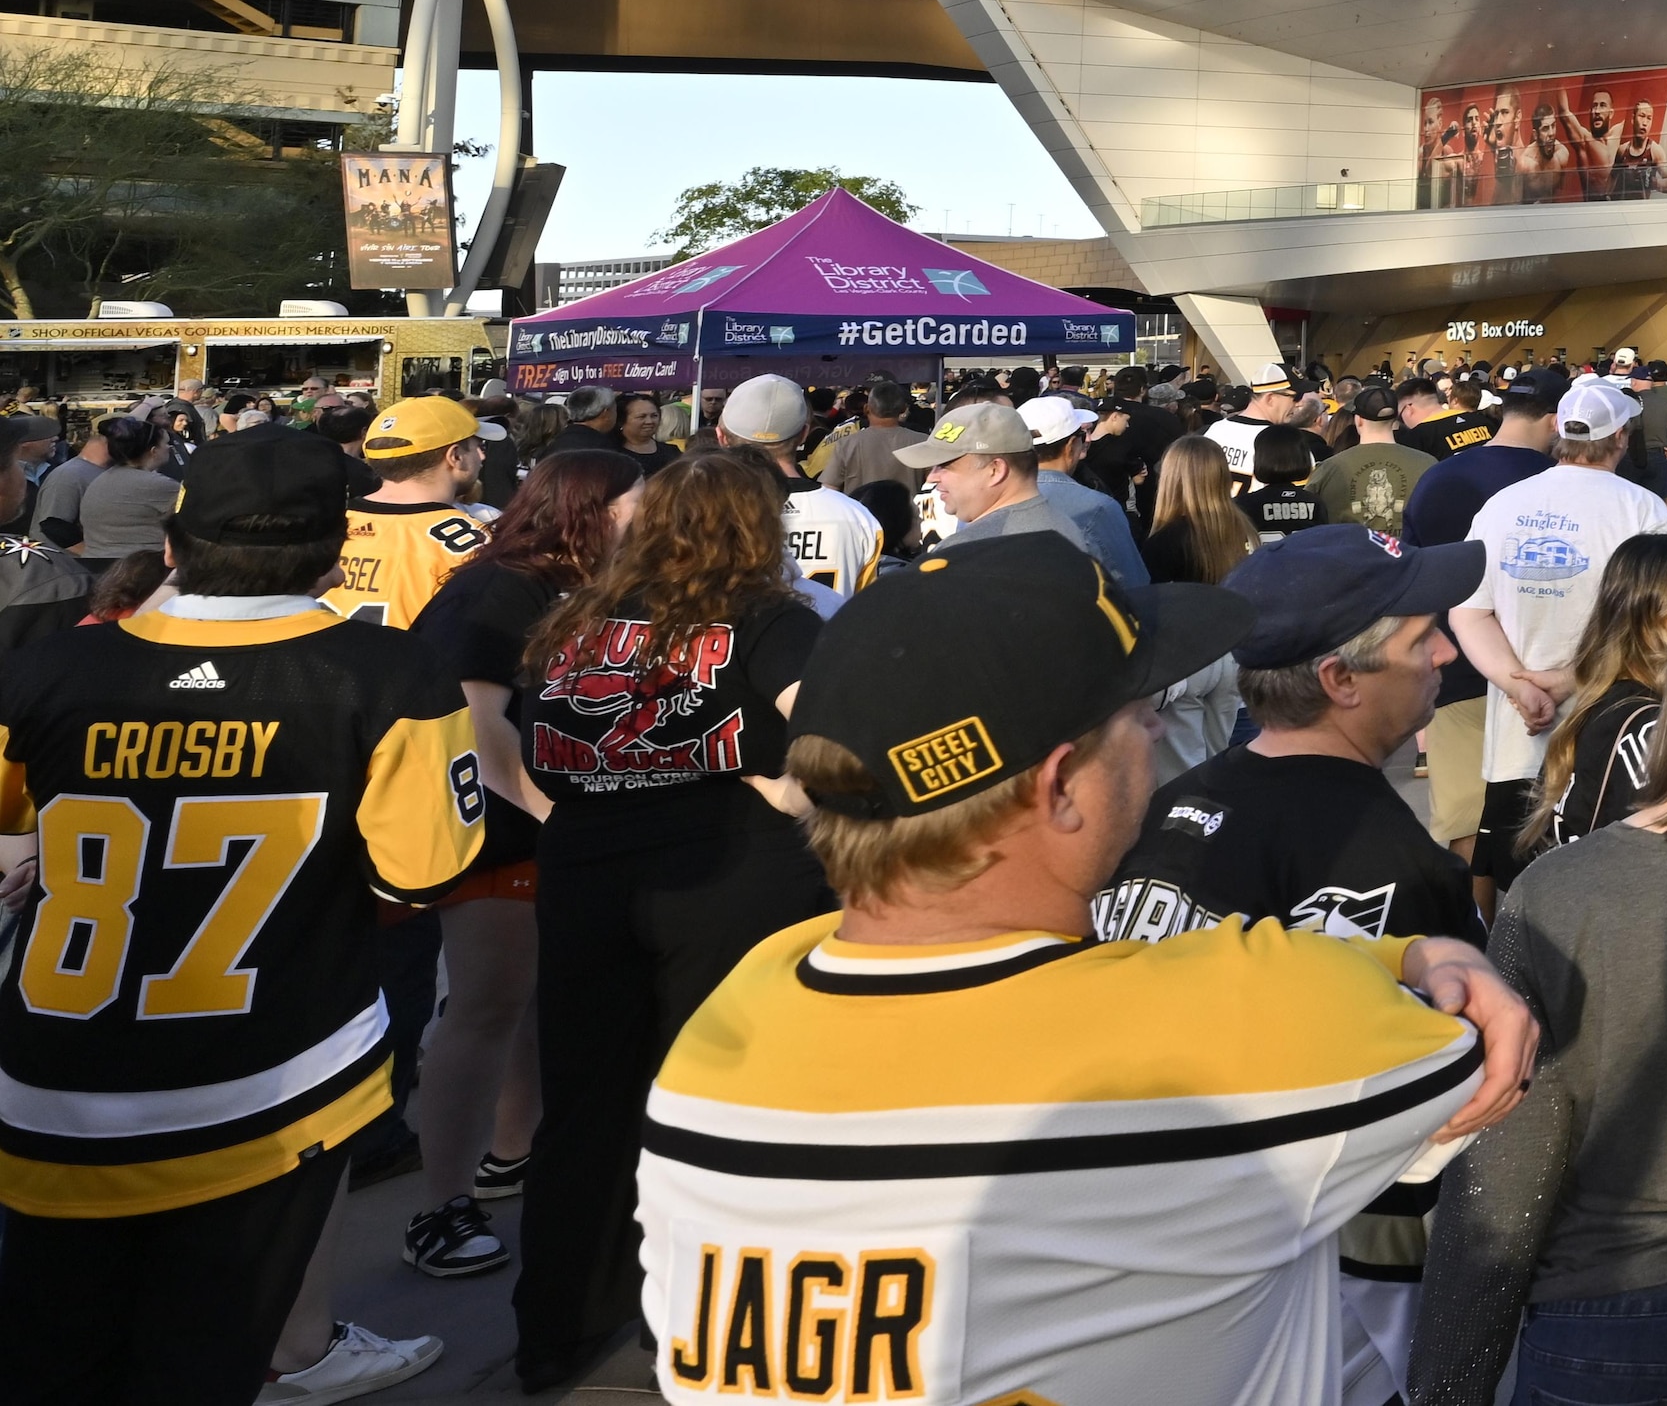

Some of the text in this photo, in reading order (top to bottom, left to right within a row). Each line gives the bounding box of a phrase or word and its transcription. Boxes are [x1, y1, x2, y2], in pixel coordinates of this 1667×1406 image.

[805, 256, 833, 264] The
[816, 263, 906, 279] Library
[824, 276, 925, 290] District
[32, 325, 395, 339] SHOP OFFICIAL VEGAS GOLDEN KNIGHTS MERCHANDISE
[548, 326, 651, 351] TheLibraryDistrict.org
[725, 323, 764, 334] Library
[725, 332, 767, 342] District
[838, 317, 1027, 345] #GetCarded
[1064, 323, 1096, 333] Library
[1065, 331, 1098, 340] District
[1446, 320, 1543, 343] axs Box Office
[515, 364, 556, 389] FREE
[571, 366, 583, 382] Up
[585, 365, 597, 379] for
[603, 364, 624, 377] FREE
[625, 363, 653, 380] Library
[655, 361, 677, 376] Card!
[934, 422, 965, 443] 24
[1445, 426, 1491, 451] LEMIEUX
[1263, 502, 1315, 521] CROSBY
[1515, 515, 1579, 532] Single Fin
[428, 516, 493, 555] 8
[169, 678, 226, 690] adidas
[84, 721, 280, 779] CROSBY
[534, 707, 744, 774] AND SUCK IT
[902, 727, 977, 773] STEEL
[570, 774, 649, 784] BOURBON
[920, 753, 980, 792] CITY
[448, 749, 486, 827] 8
[584, 782, 622, 793] NEW
[18, 791, 328, 1021] 87
[672, 1242, 934, 1405] JAGR
